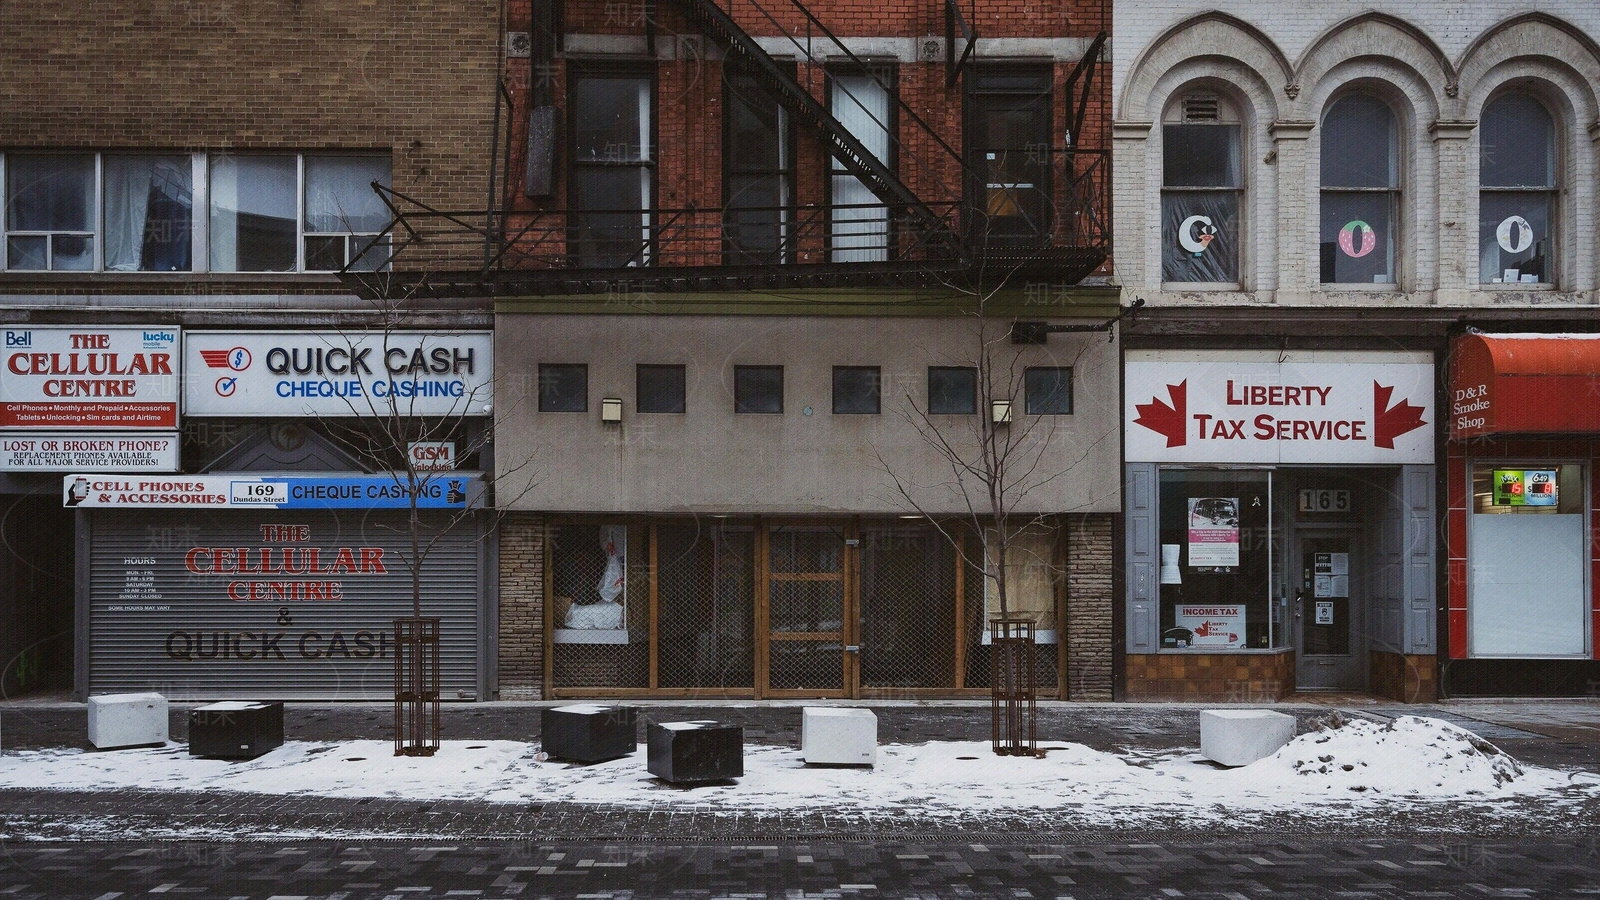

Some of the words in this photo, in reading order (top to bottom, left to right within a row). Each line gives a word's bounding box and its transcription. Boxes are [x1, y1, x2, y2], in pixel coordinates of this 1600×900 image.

[6, 331, 32, 345] Bell
[69, 334, 111, 349] THE
[143, 331, 174, 343] lucky
[7, 352, 173, 375] CELLULAR
[265, 347, 372, 375] QUICK
[386, 347, 475, 375] CASH
[43, 379, 137, 397] CENTRE
[276, 380, 361, 398] CHEQUE
[372, 380, 465, 398] CASHING
[1225, 379, 1333, 406] LIBERTY
[54, 404, 81, 412] Monthly
[97, 404, 124, 412] Prepaid
[1453, 398, 1490, 415] Smoke
[46, 414, 81, 422] Unlocking
[1457, 416, 1485, 429] Shop
[1193, 413, 1246, 440] TAX
[1253, 413, 1367, 441] SERVICE
[3, 440, 37, 451] LOST
[41, 440, 59, 451] OR
[63, 440, 114, 451] BROKEN
[118, 440, 169, 451] PHONE?
[413, 446, 449, 460] GSM
[92, 481, 134, 492] CELL
[138, 481, 205, 492] PHONES
[246, 484, 275, 496] 169
[292, 485, 362, 499] CHEQUE
[366, 485, 442, 499] CASHNG
[98, 493, 112, 504] &
[116, 493, 227, 504] ACCESSORIES
[1303, 491, 1348, 510] 165
[260, 523, 311, 542] THE
[123, 557, 156, 565] HOURS
[184, 547, 388, 575] CELLULAR
[226, 580, 344, 601] CENTRE
[276, 607, 293, 626] &
[1183, 608, 1218, 616] INCOME
[1220, 608, 1238, 616] TAX
[165, 630, 287, 662] QUICK
